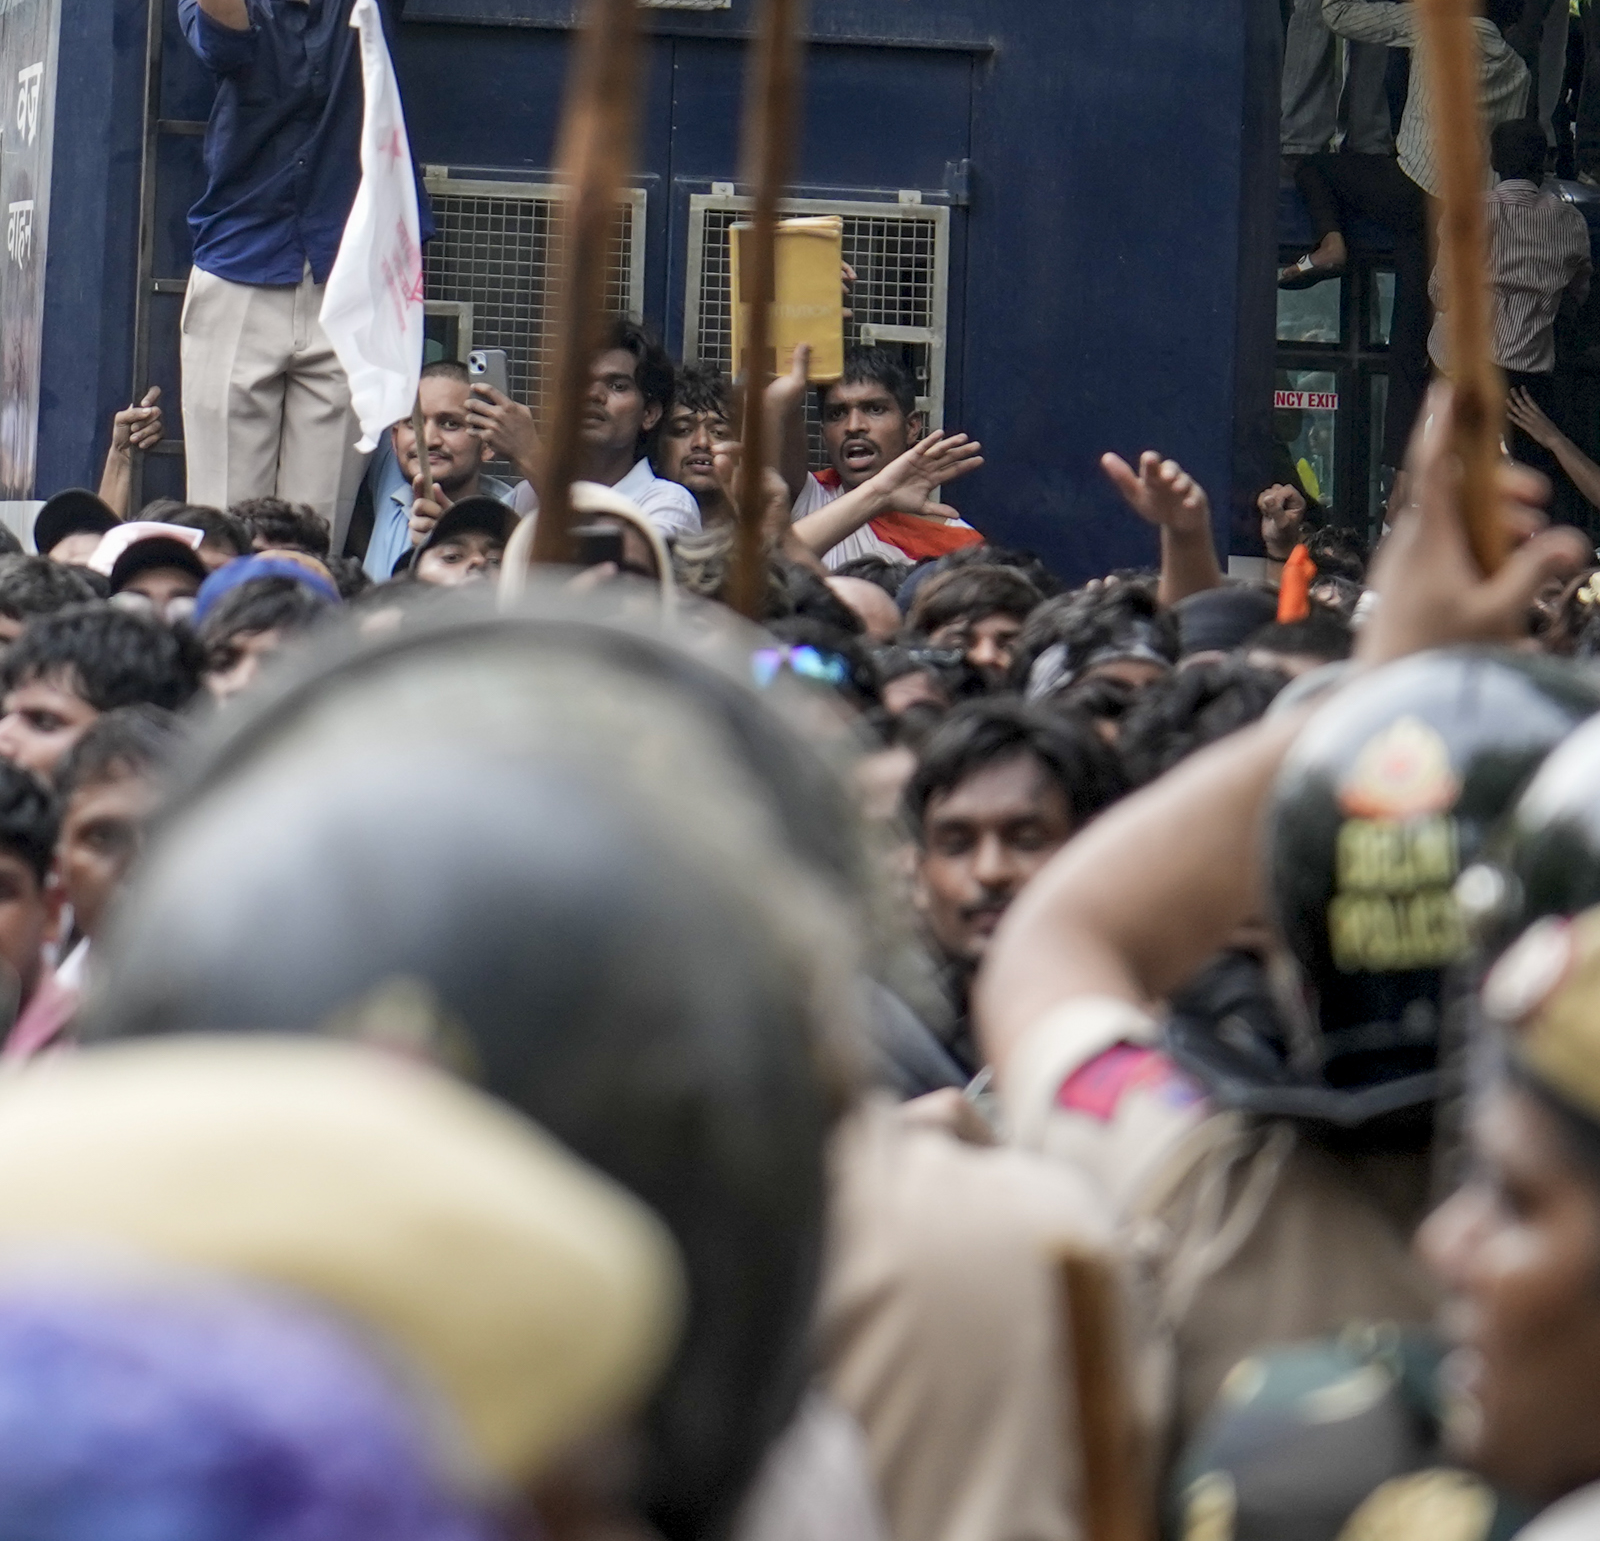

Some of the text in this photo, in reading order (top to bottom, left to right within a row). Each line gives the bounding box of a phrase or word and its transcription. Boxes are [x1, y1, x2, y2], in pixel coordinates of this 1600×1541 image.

[17, 61, 44, 147] वज्र
[8, 200, 34, 270] वाहन
[1308, 393, 1338, 409] EXIT
